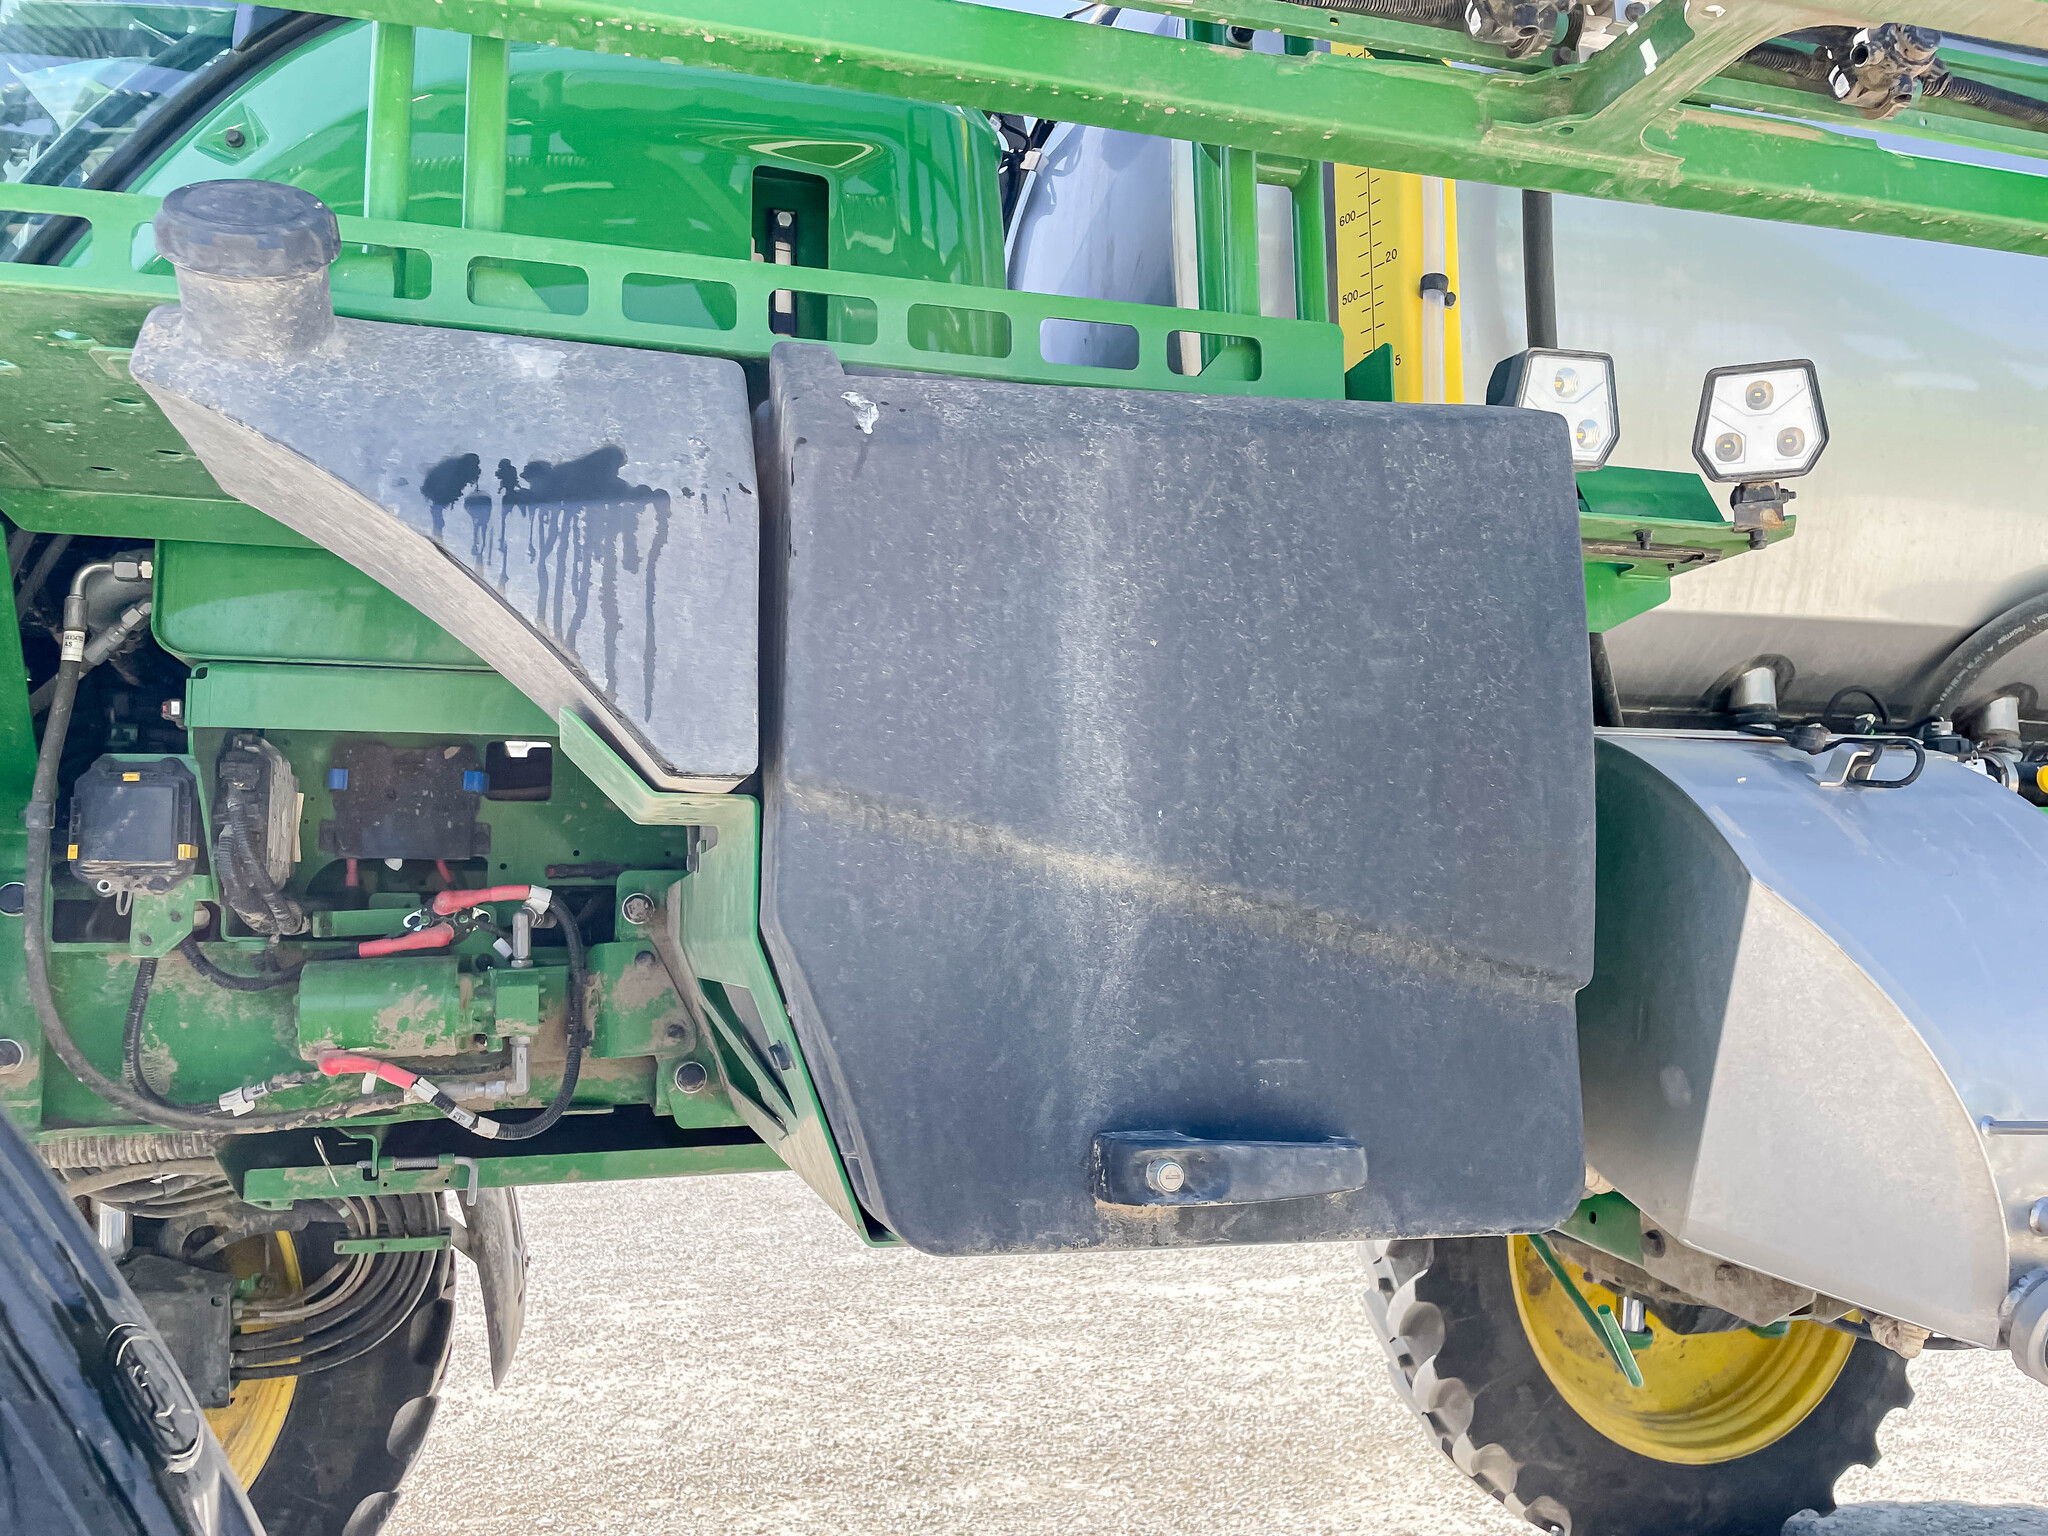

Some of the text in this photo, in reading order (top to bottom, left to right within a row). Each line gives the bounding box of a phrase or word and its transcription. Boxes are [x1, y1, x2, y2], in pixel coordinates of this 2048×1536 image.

[1339, 210, 1356, 227] 600
[1385, 248, 1398, 263] 20
[1342, 289, 1359, 306] 500
